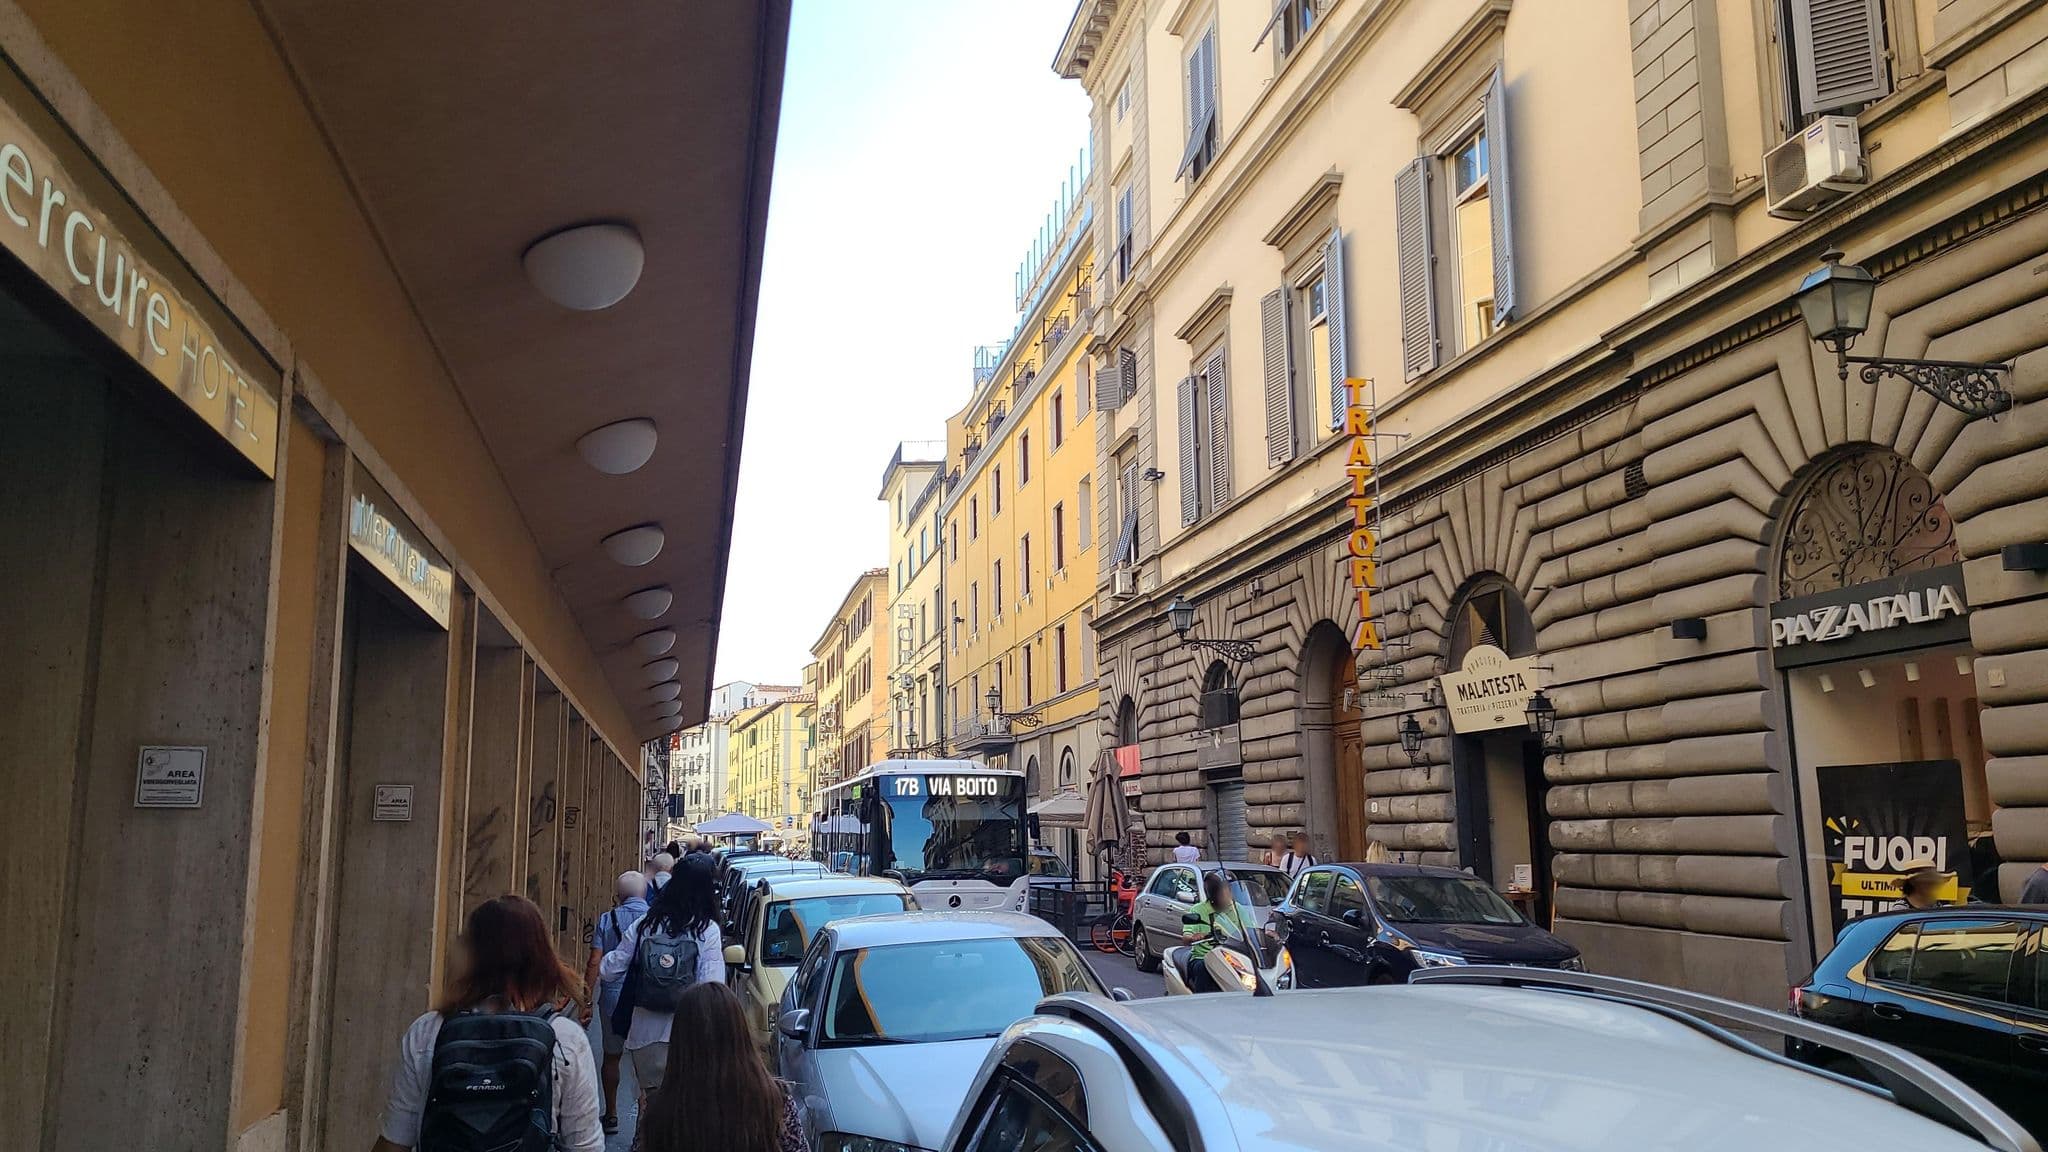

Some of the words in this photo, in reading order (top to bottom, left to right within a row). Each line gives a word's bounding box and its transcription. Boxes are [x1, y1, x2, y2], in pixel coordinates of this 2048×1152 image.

[180, 320, 259, 442] HOTEL
[1344, 377, 1381, 650] TRATTORIA
[1456, 673, 1528, 702] MALATESTA
[1457, 703, 1486, 715] TRATTORIA
[1491, 699, 1518, 709] PIZZERIA
[894, 777, 919, 796] 17B
[928, 777, 952, 796] VIA
[956, 777, 998, 796] BOITO
[1844, 836, 1947, 872] FUORI
